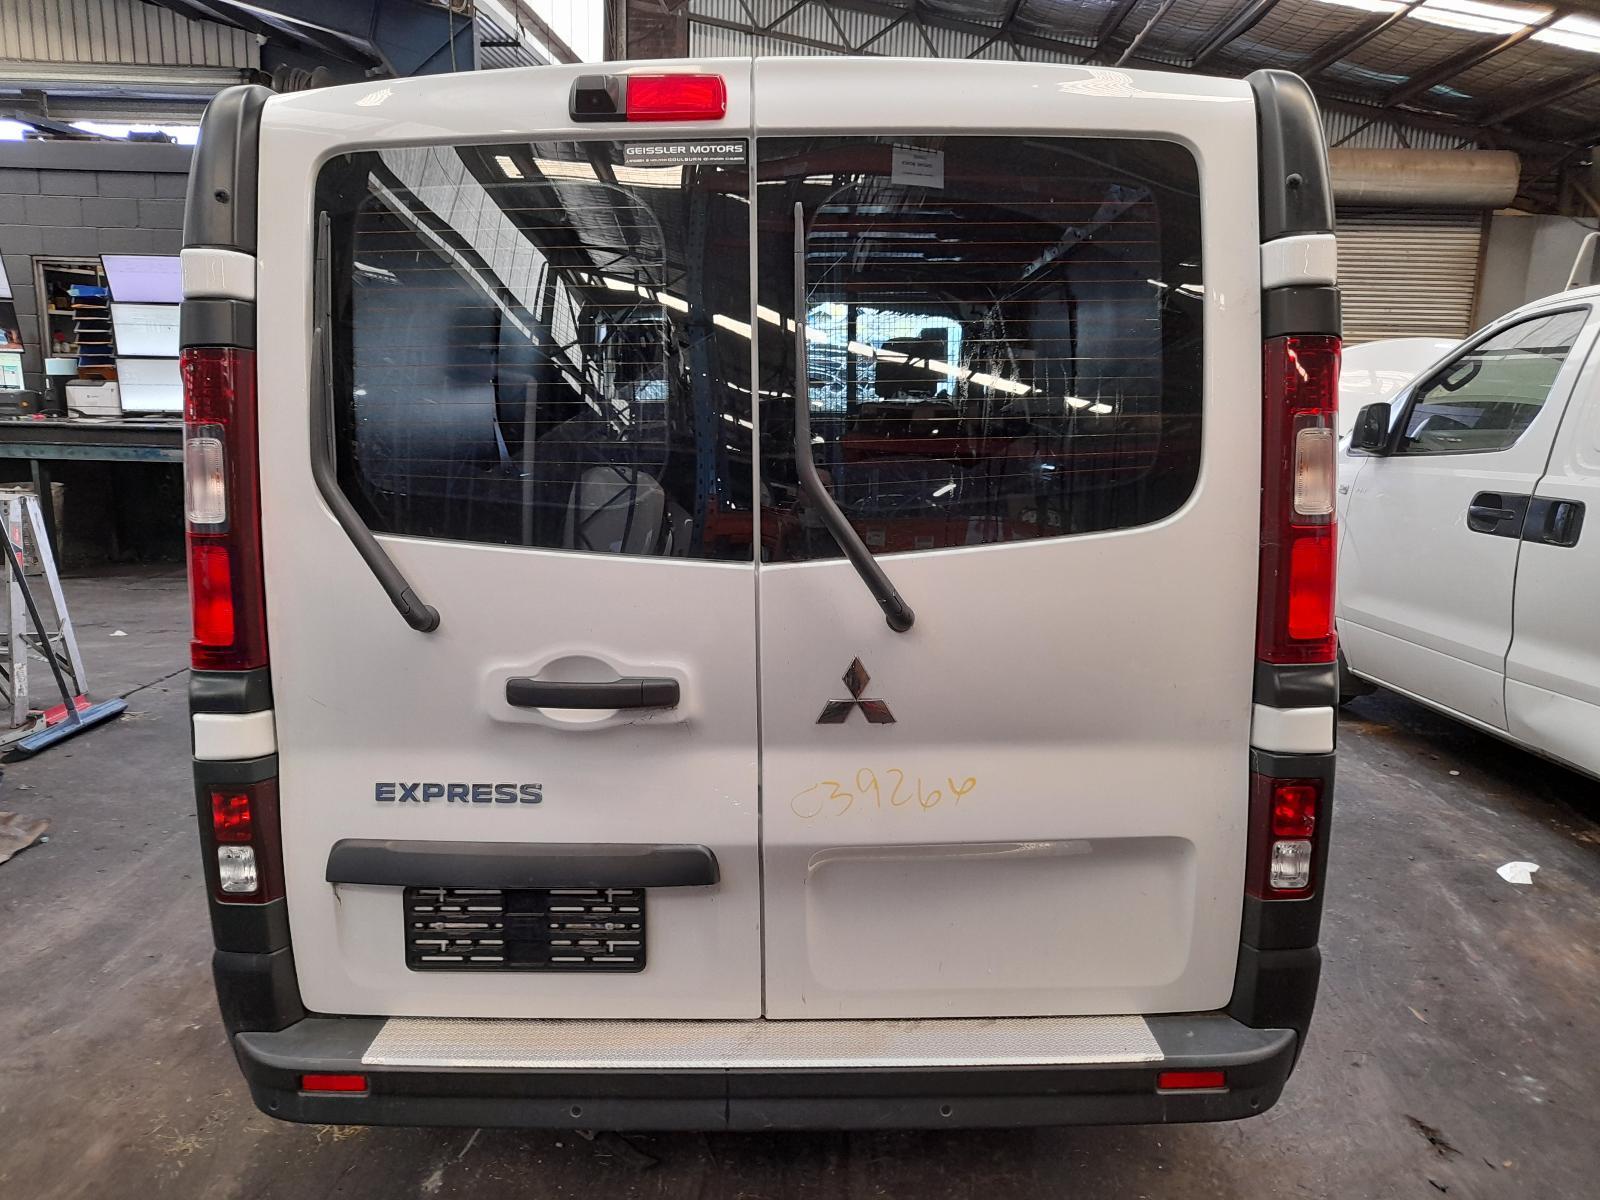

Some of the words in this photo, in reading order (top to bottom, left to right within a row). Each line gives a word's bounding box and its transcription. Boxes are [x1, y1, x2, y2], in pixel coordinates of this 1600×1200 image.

[626, 146, 686, 155] GEISSLER
[690, 145, 743, 154] MOTORS
[375, 782, 543, 804] EXPRESS
